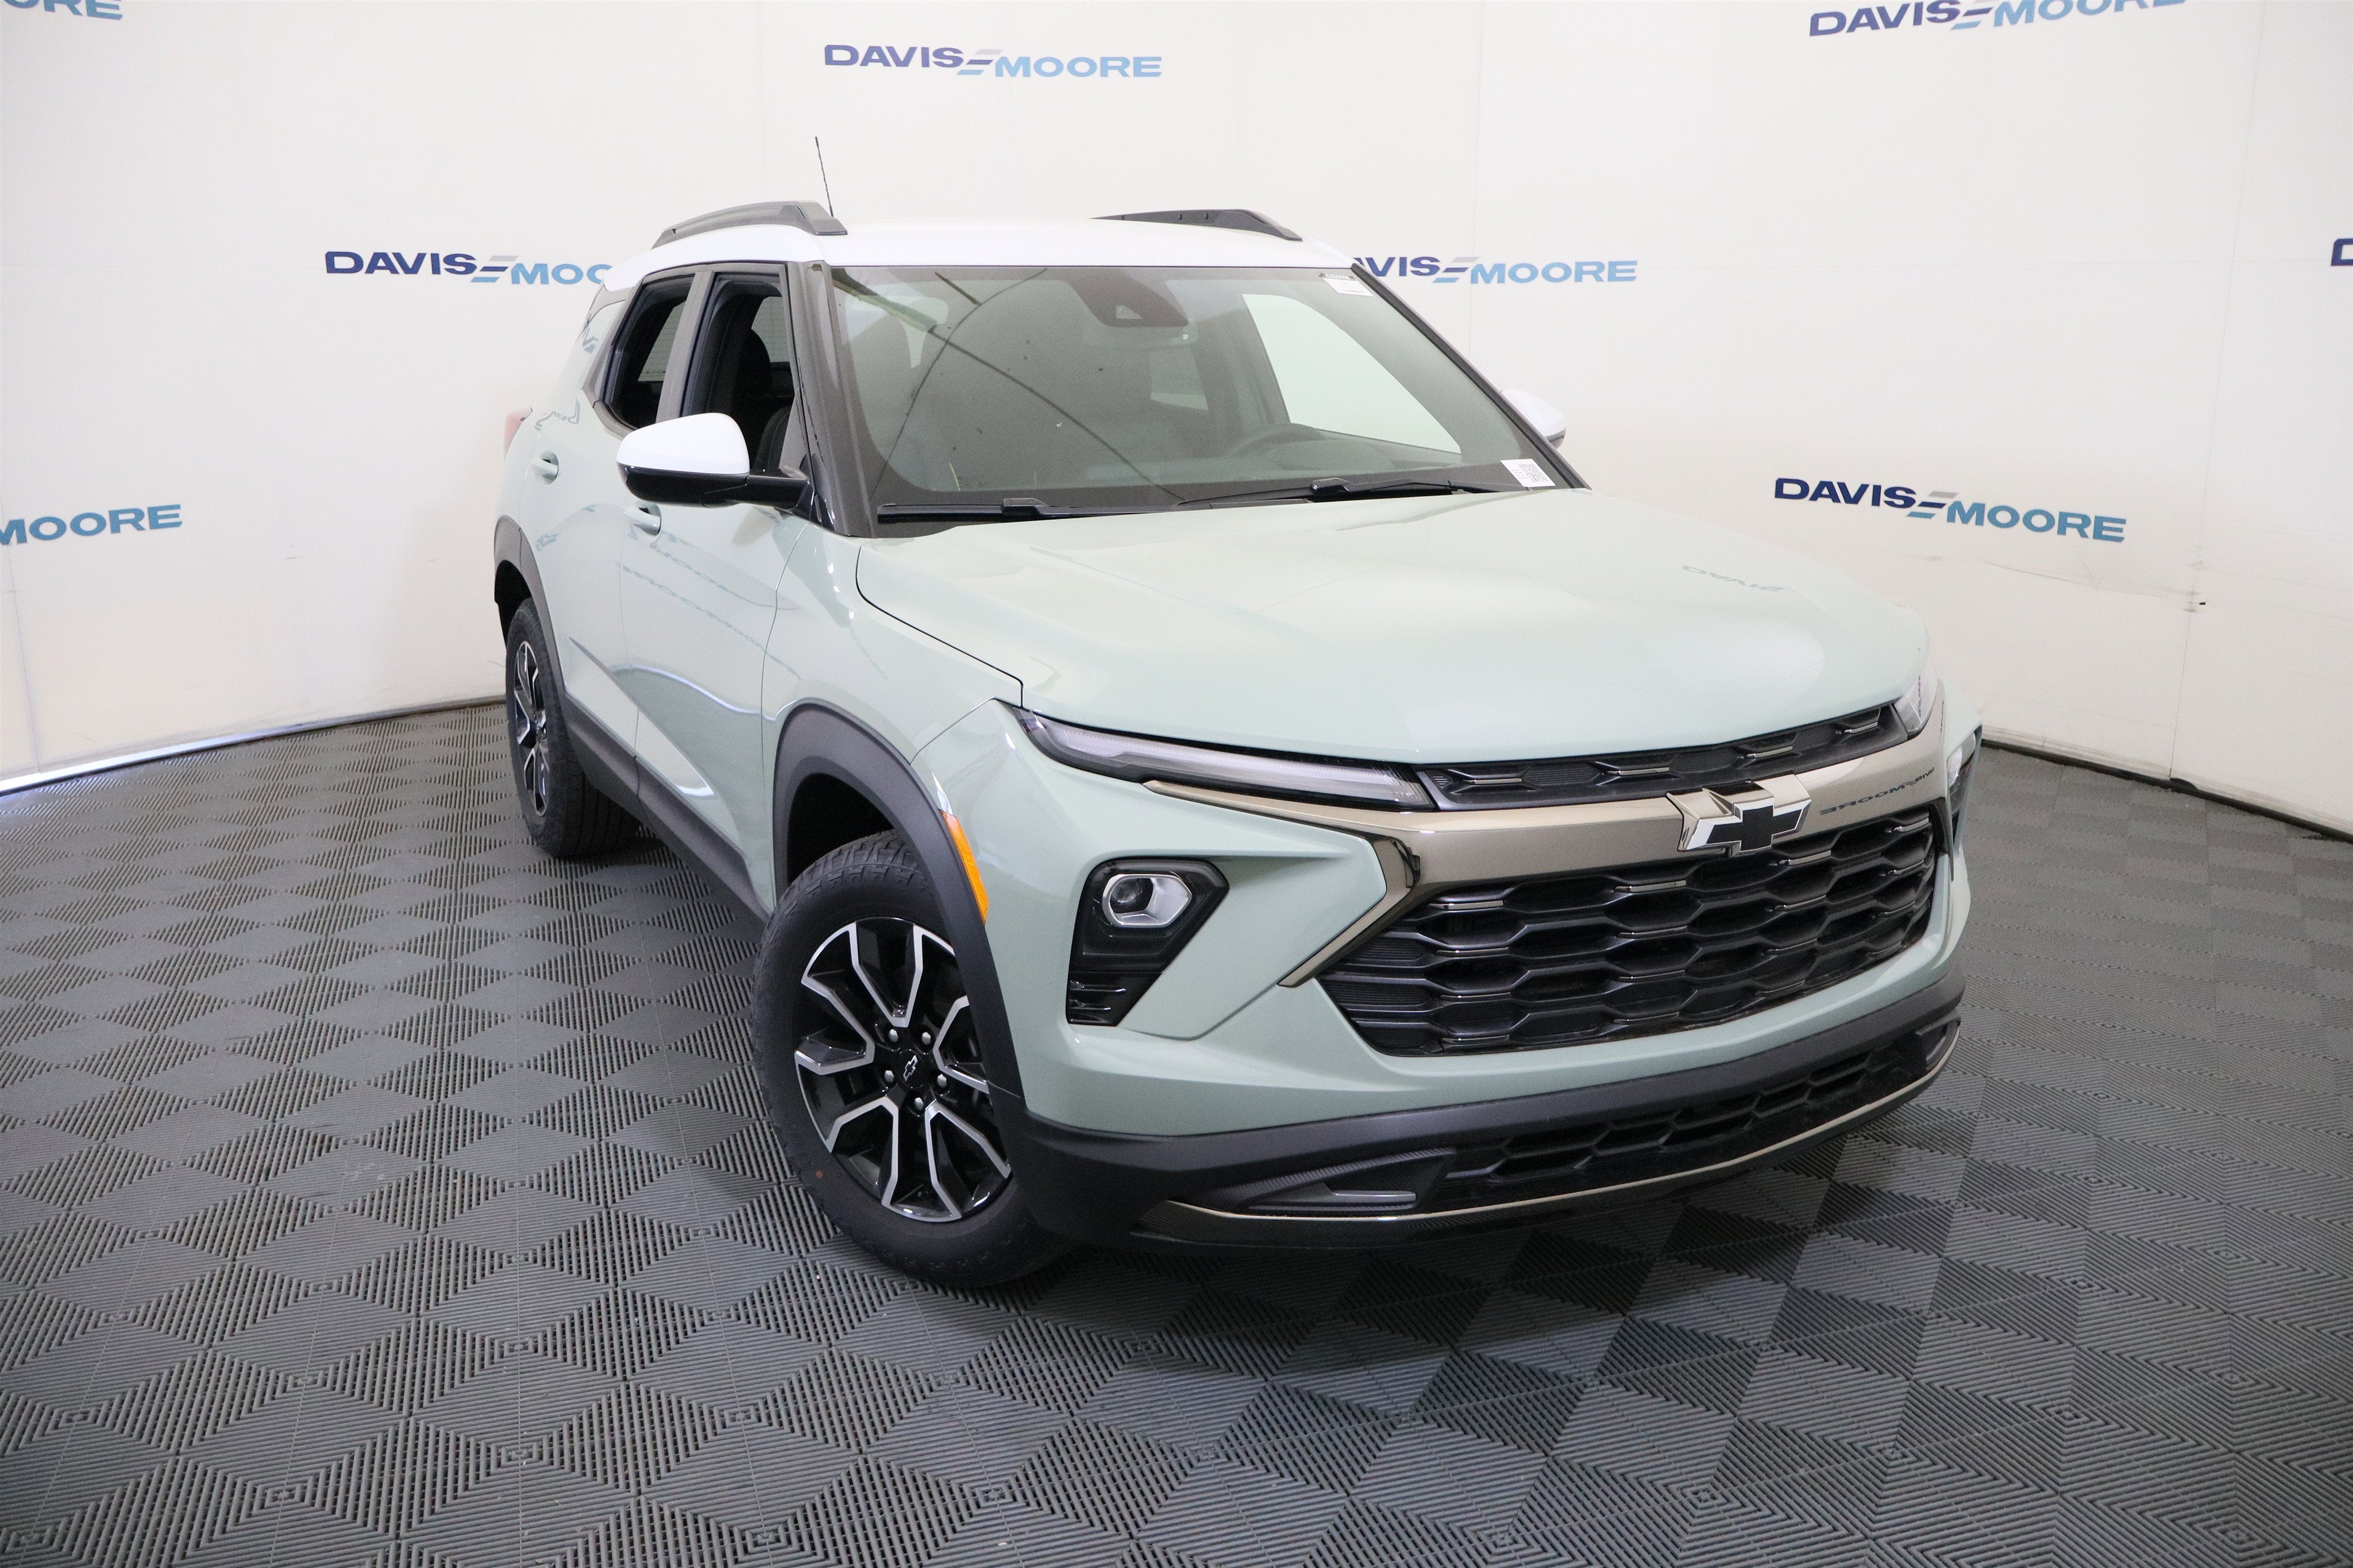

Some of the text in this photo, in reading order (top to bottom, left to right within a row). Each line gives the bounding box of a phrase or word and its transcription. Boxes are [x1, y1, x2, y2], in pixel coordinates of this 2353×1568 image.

[1810, 0, 1961, 36] DAVIS
[824, 44, 1163, 78] DAVIS MOORE
[325, 251, 613, 285] DAVIS MOO
[1353, 256, 1638, 284] VIS MOORE
[1774, 477, 2127, 543] DAVIS MOORE
